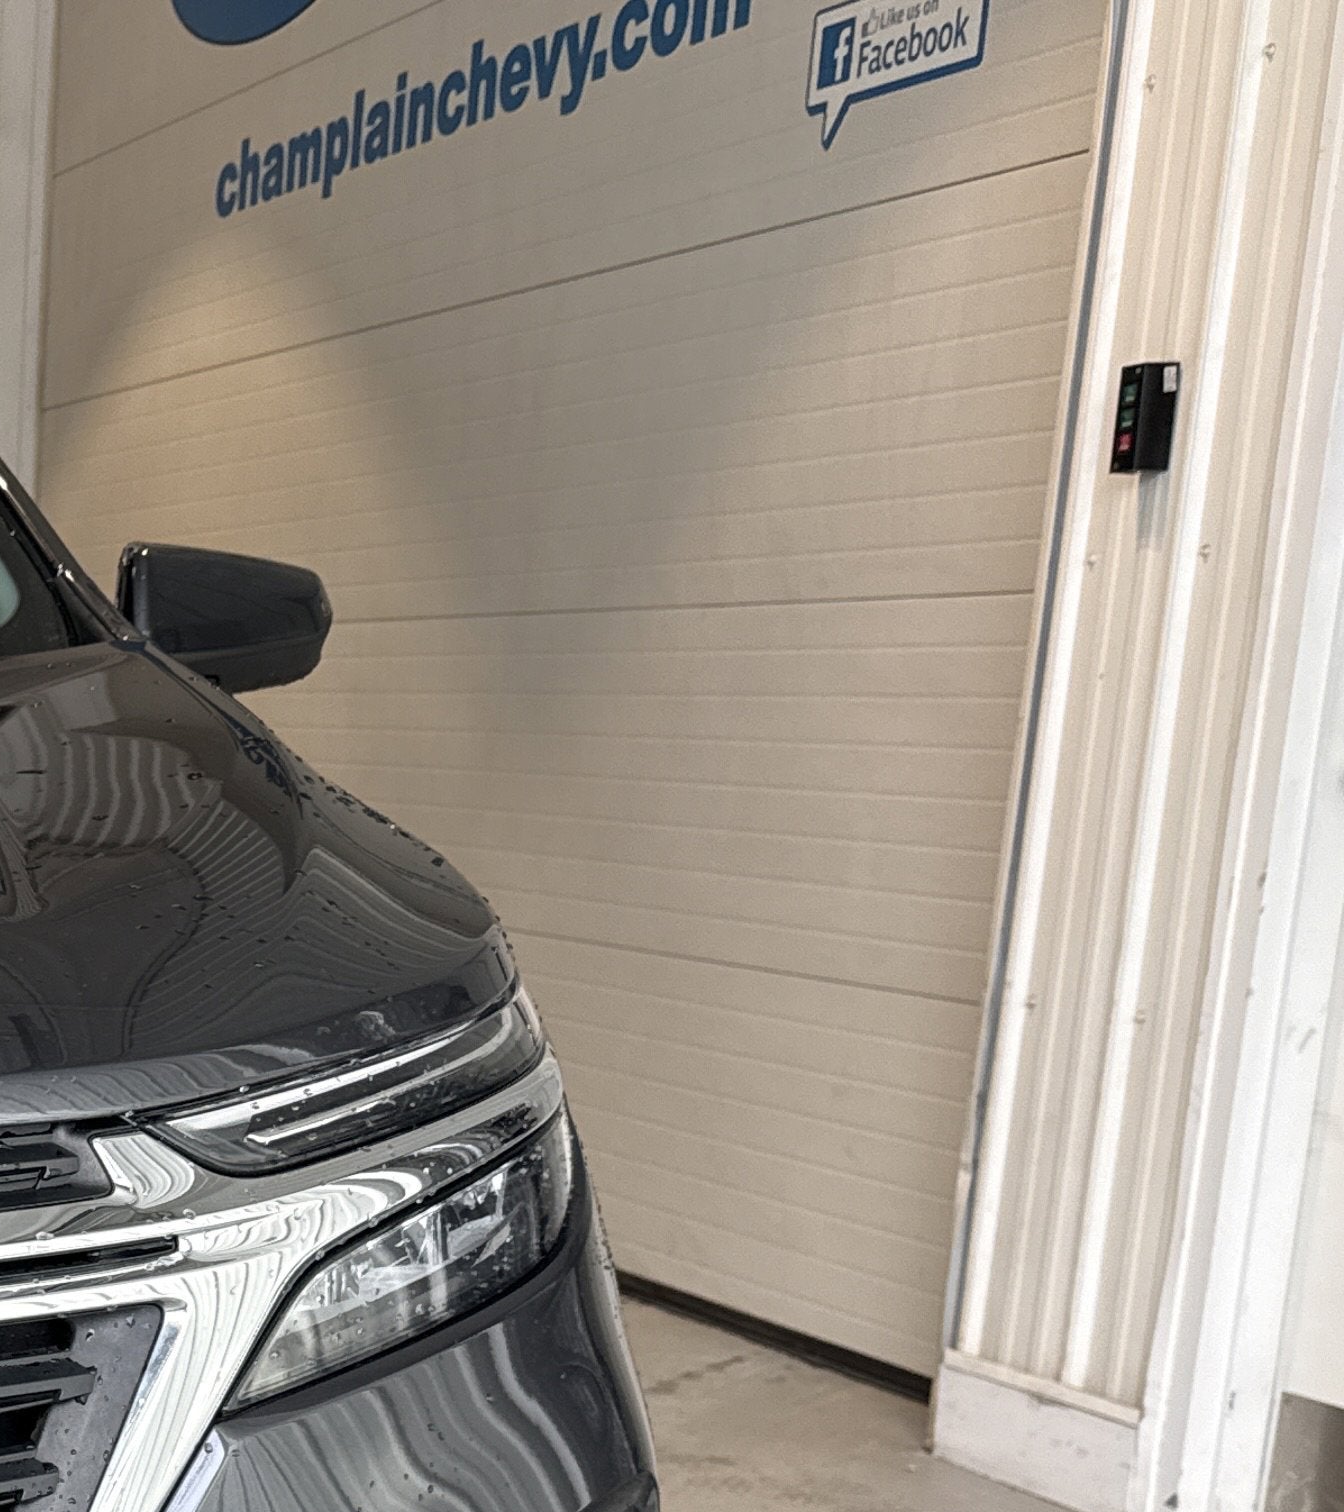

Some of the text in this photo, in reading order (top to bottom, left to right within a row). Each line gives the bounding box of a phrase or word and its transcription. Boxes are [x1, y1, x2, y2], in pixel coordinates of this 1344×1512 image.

[879, 6, 904, 30] Like
[906, 1, 922, 21] us
[857, 7, 970, 78] Facebook
